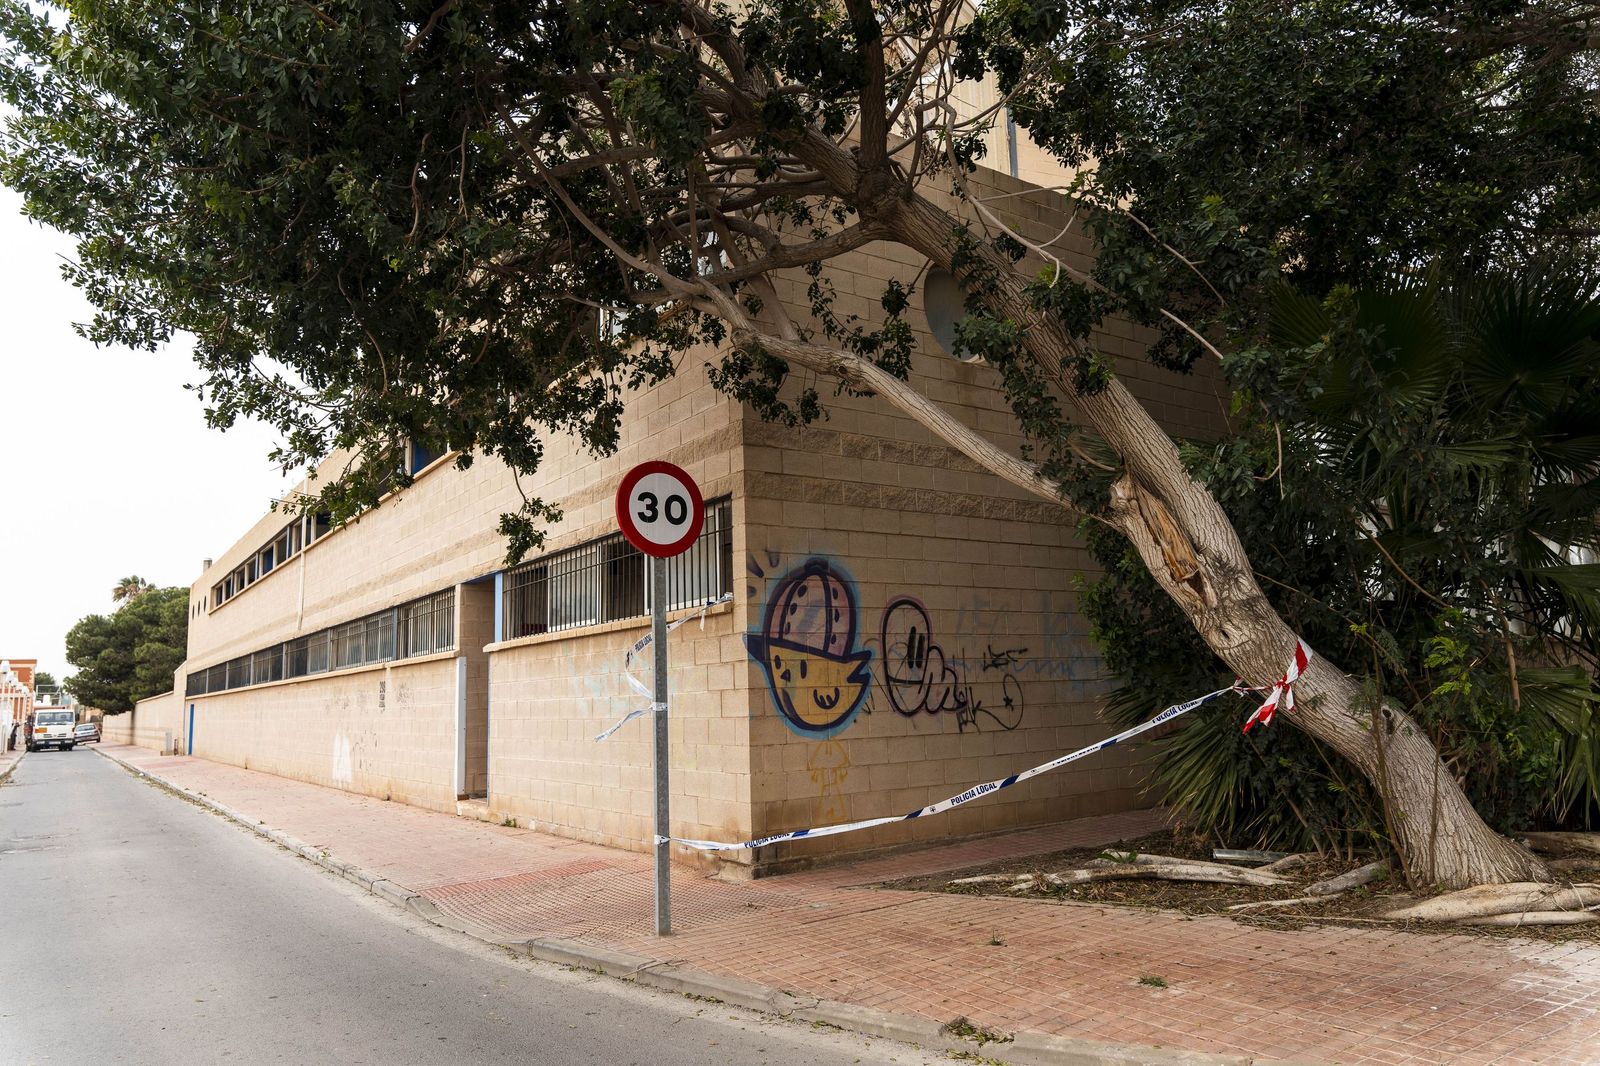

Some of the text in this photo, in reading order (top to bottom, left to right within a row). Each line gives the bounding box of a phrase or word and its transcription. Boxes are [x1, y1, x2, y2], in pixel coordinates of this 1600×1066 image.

[637, 491, 688, 526] 30
[951, 782, 997, 806] POLICIA LOCAL
